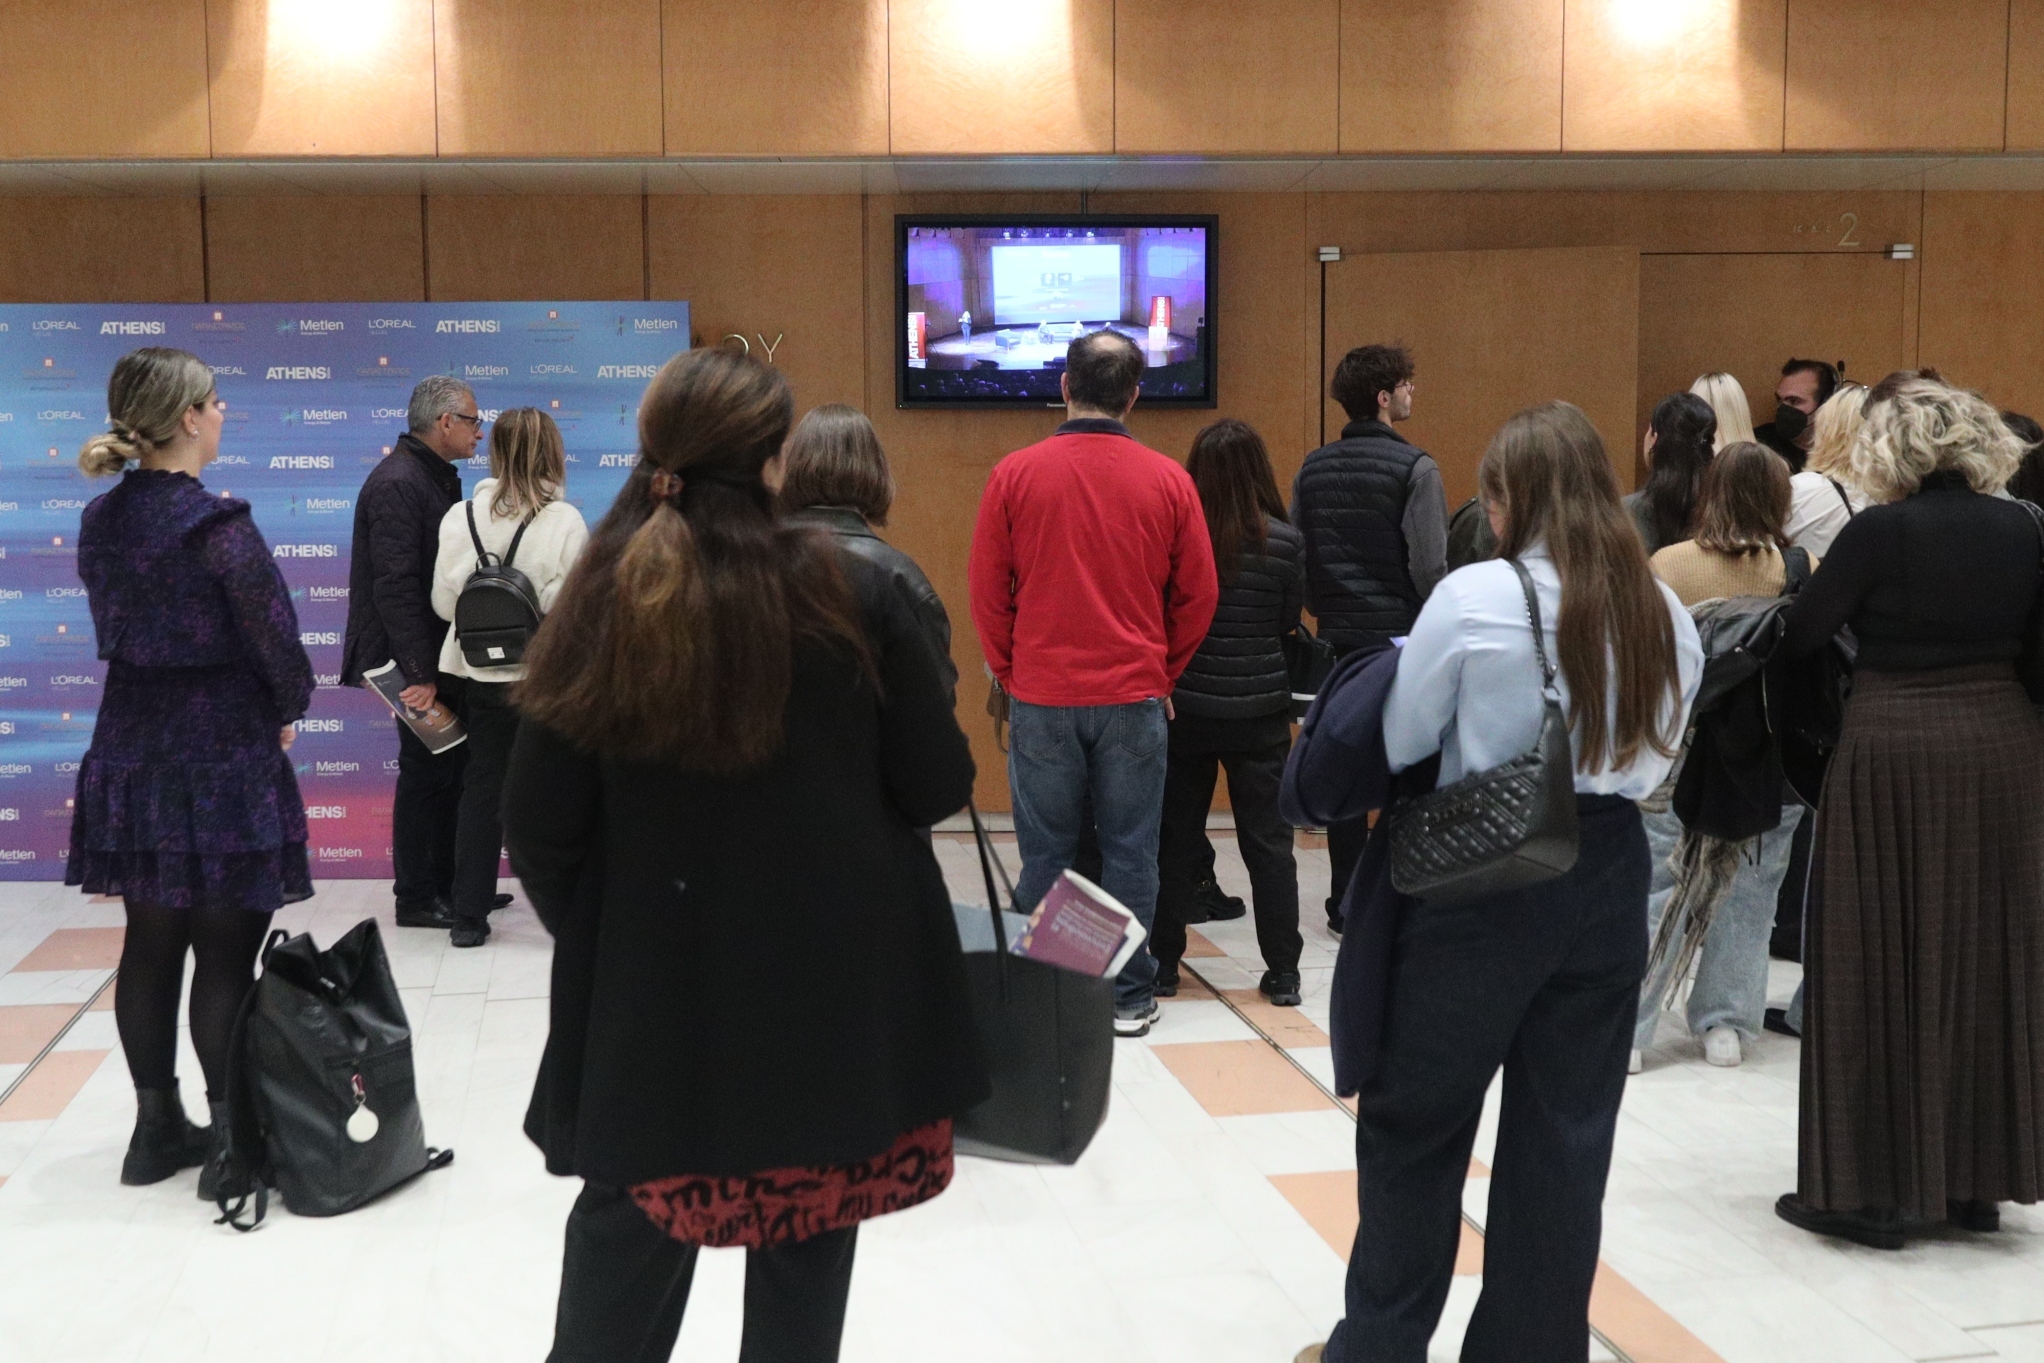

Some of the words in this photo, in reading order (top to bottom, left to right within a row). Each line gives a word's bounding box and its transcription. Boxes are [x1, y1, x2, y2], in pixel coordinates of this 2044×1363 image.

[1838, 212, 1860, 246] 2
[300, 319, 344, 331] Metlen
[634, 318, 677, 329] Metlen
[207, 365, 246, 375] ORÉAL
[465, 364, 509, 376] Metlen
[303, 409, 347, 421] Metlen
[211, 455, 250, 465] ORÉAL
[307, 498, 350, 509] Metlen
[46, 587, 88, 597] L'ORÉA
[299, 632, 337, 645] HENS
[291, 719, 340, 732] THENS
[0, 763, 31, 774] etlen
[55, 762, 80, 772] L'OR
[316, 760, 359, 772] Metlen
[304, 805, 343, 819] HENS
[319, 847, 362, 858] Metlen
